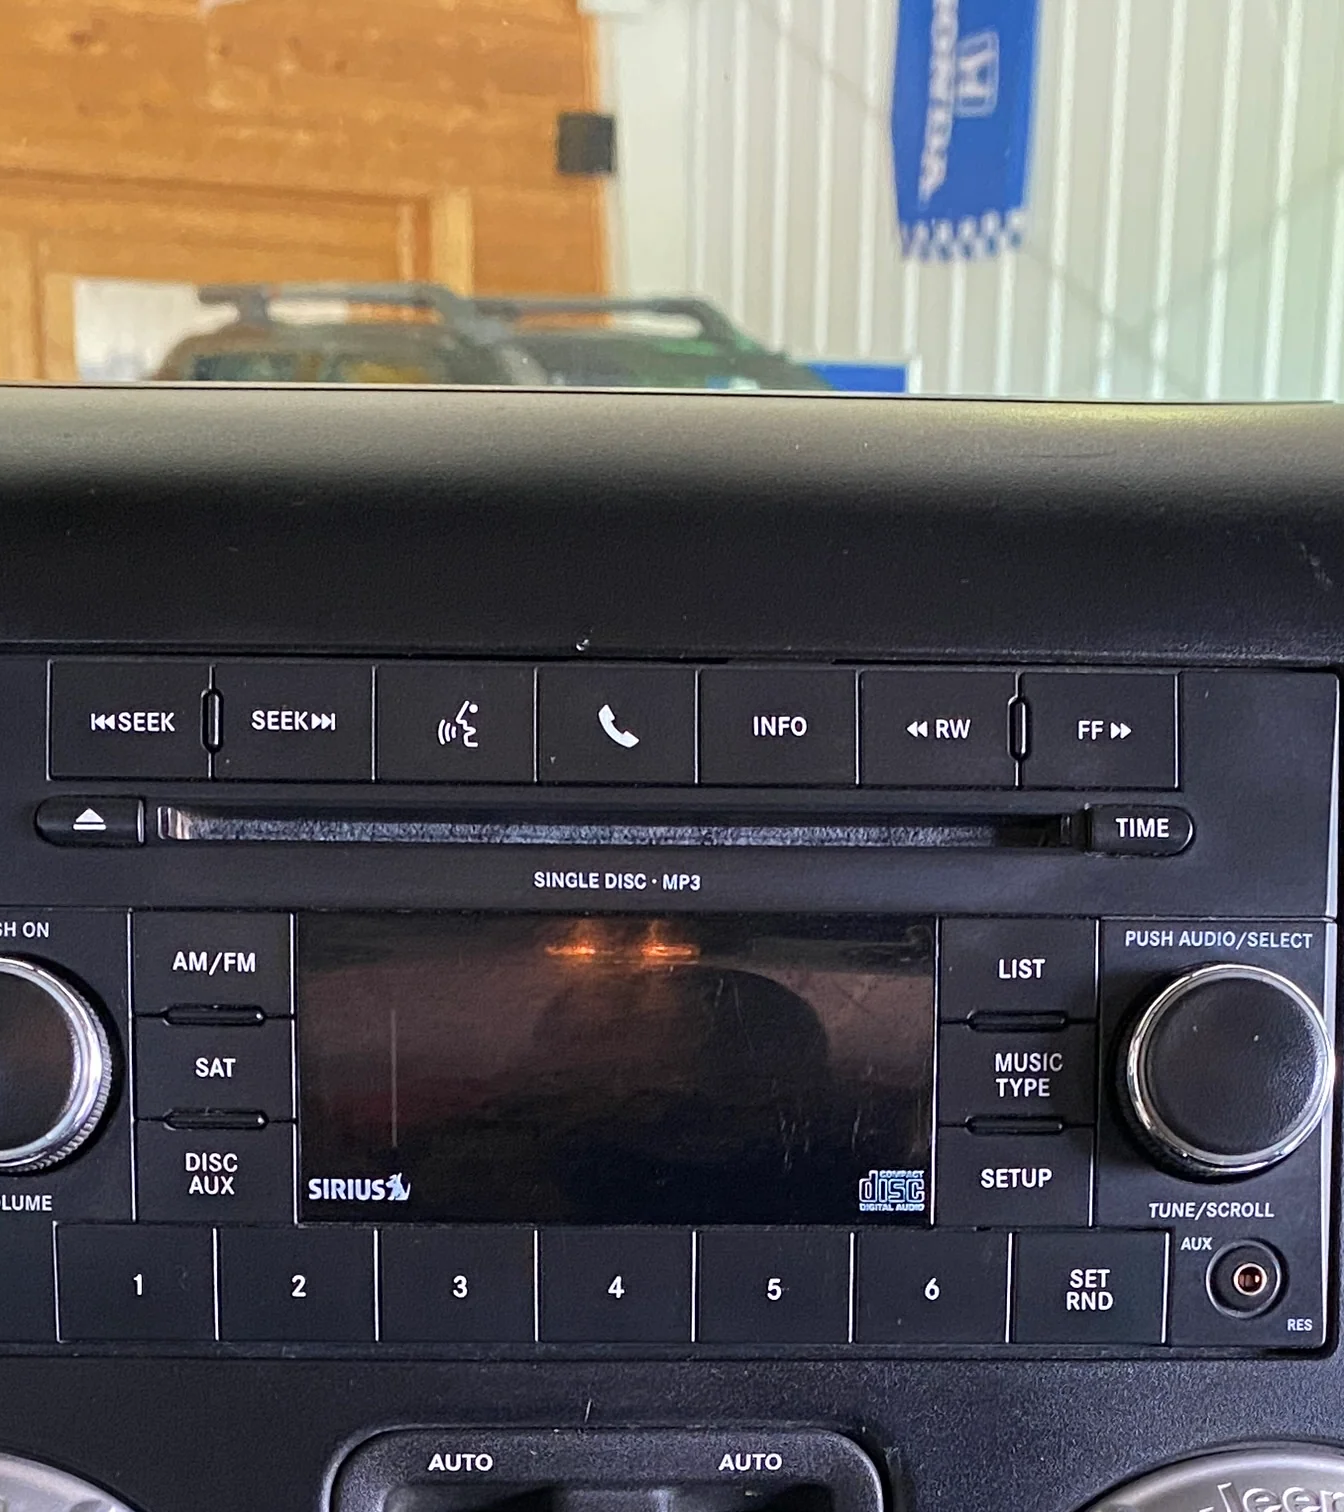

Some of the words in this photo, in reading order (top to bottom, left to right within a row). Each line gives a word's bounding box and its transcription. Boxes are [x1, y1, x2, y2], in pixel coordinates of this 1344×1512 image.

[116, 710, 176, 733] SEEK
[250, 709, 310, 732] SEEK
[752, 715, 808, 738] INFO
[934, 717, 971, 740] RW
[1077, 719, 1104, 741] FF
[1115, 817, 1171, 839] TIME
[534, 871, 599, 890] SINGLE
[603, 871, 647, 890] DISC
[661, 872, 702, 892] MP3
[22, 920, 50, 939] ON
[1125, 929, 1175, 948] PUSH
[1178, 930, 1314, 952] AUDIO/SELECT
[172, 951, 257, 977] AM/FM
[997, 958, 1047, 980] LIST
[194, 1056, 237, 1079] SAT
[994, 1052, 1064, 1074] MUSIC
[994, 1077, 1051, 1099] TYPE
[184, 1152, 239, 1174] DISC
[879, 1170, 925, 1178] COMPACT
[187, 1174, 236, 1196] AUX
[979, 1166, 1054, 1190] SETUP
[307, 1178, 385, 1202] SIRIUS
[859, 1203, 894, 1211] DIGITAL
[895, 1203, 925, 1211] AUDIO
[1147, 1200, 1276, 1222] TUNE/SCROLL
[1180, 1236, 1214, 1252] AUX
[132, 1273, 144, 1297] 1
[290, 1274, 307, 1298] 2
[451, 1275, 468, 1299] 3
[607, 1275, 626, 1299] 4
[766, 1277, 783, 1301] 5
[923, 1277, 941, 1302] 6
[1068, 1267, 1112, 1290] SET
[1065, 1290, 1115, 1312] RND
[1286, 1317, 1314, 1333] RES
[427, 1452, 495, 1473] AUTO
[717, 1452, 784, 1472] AUTO
